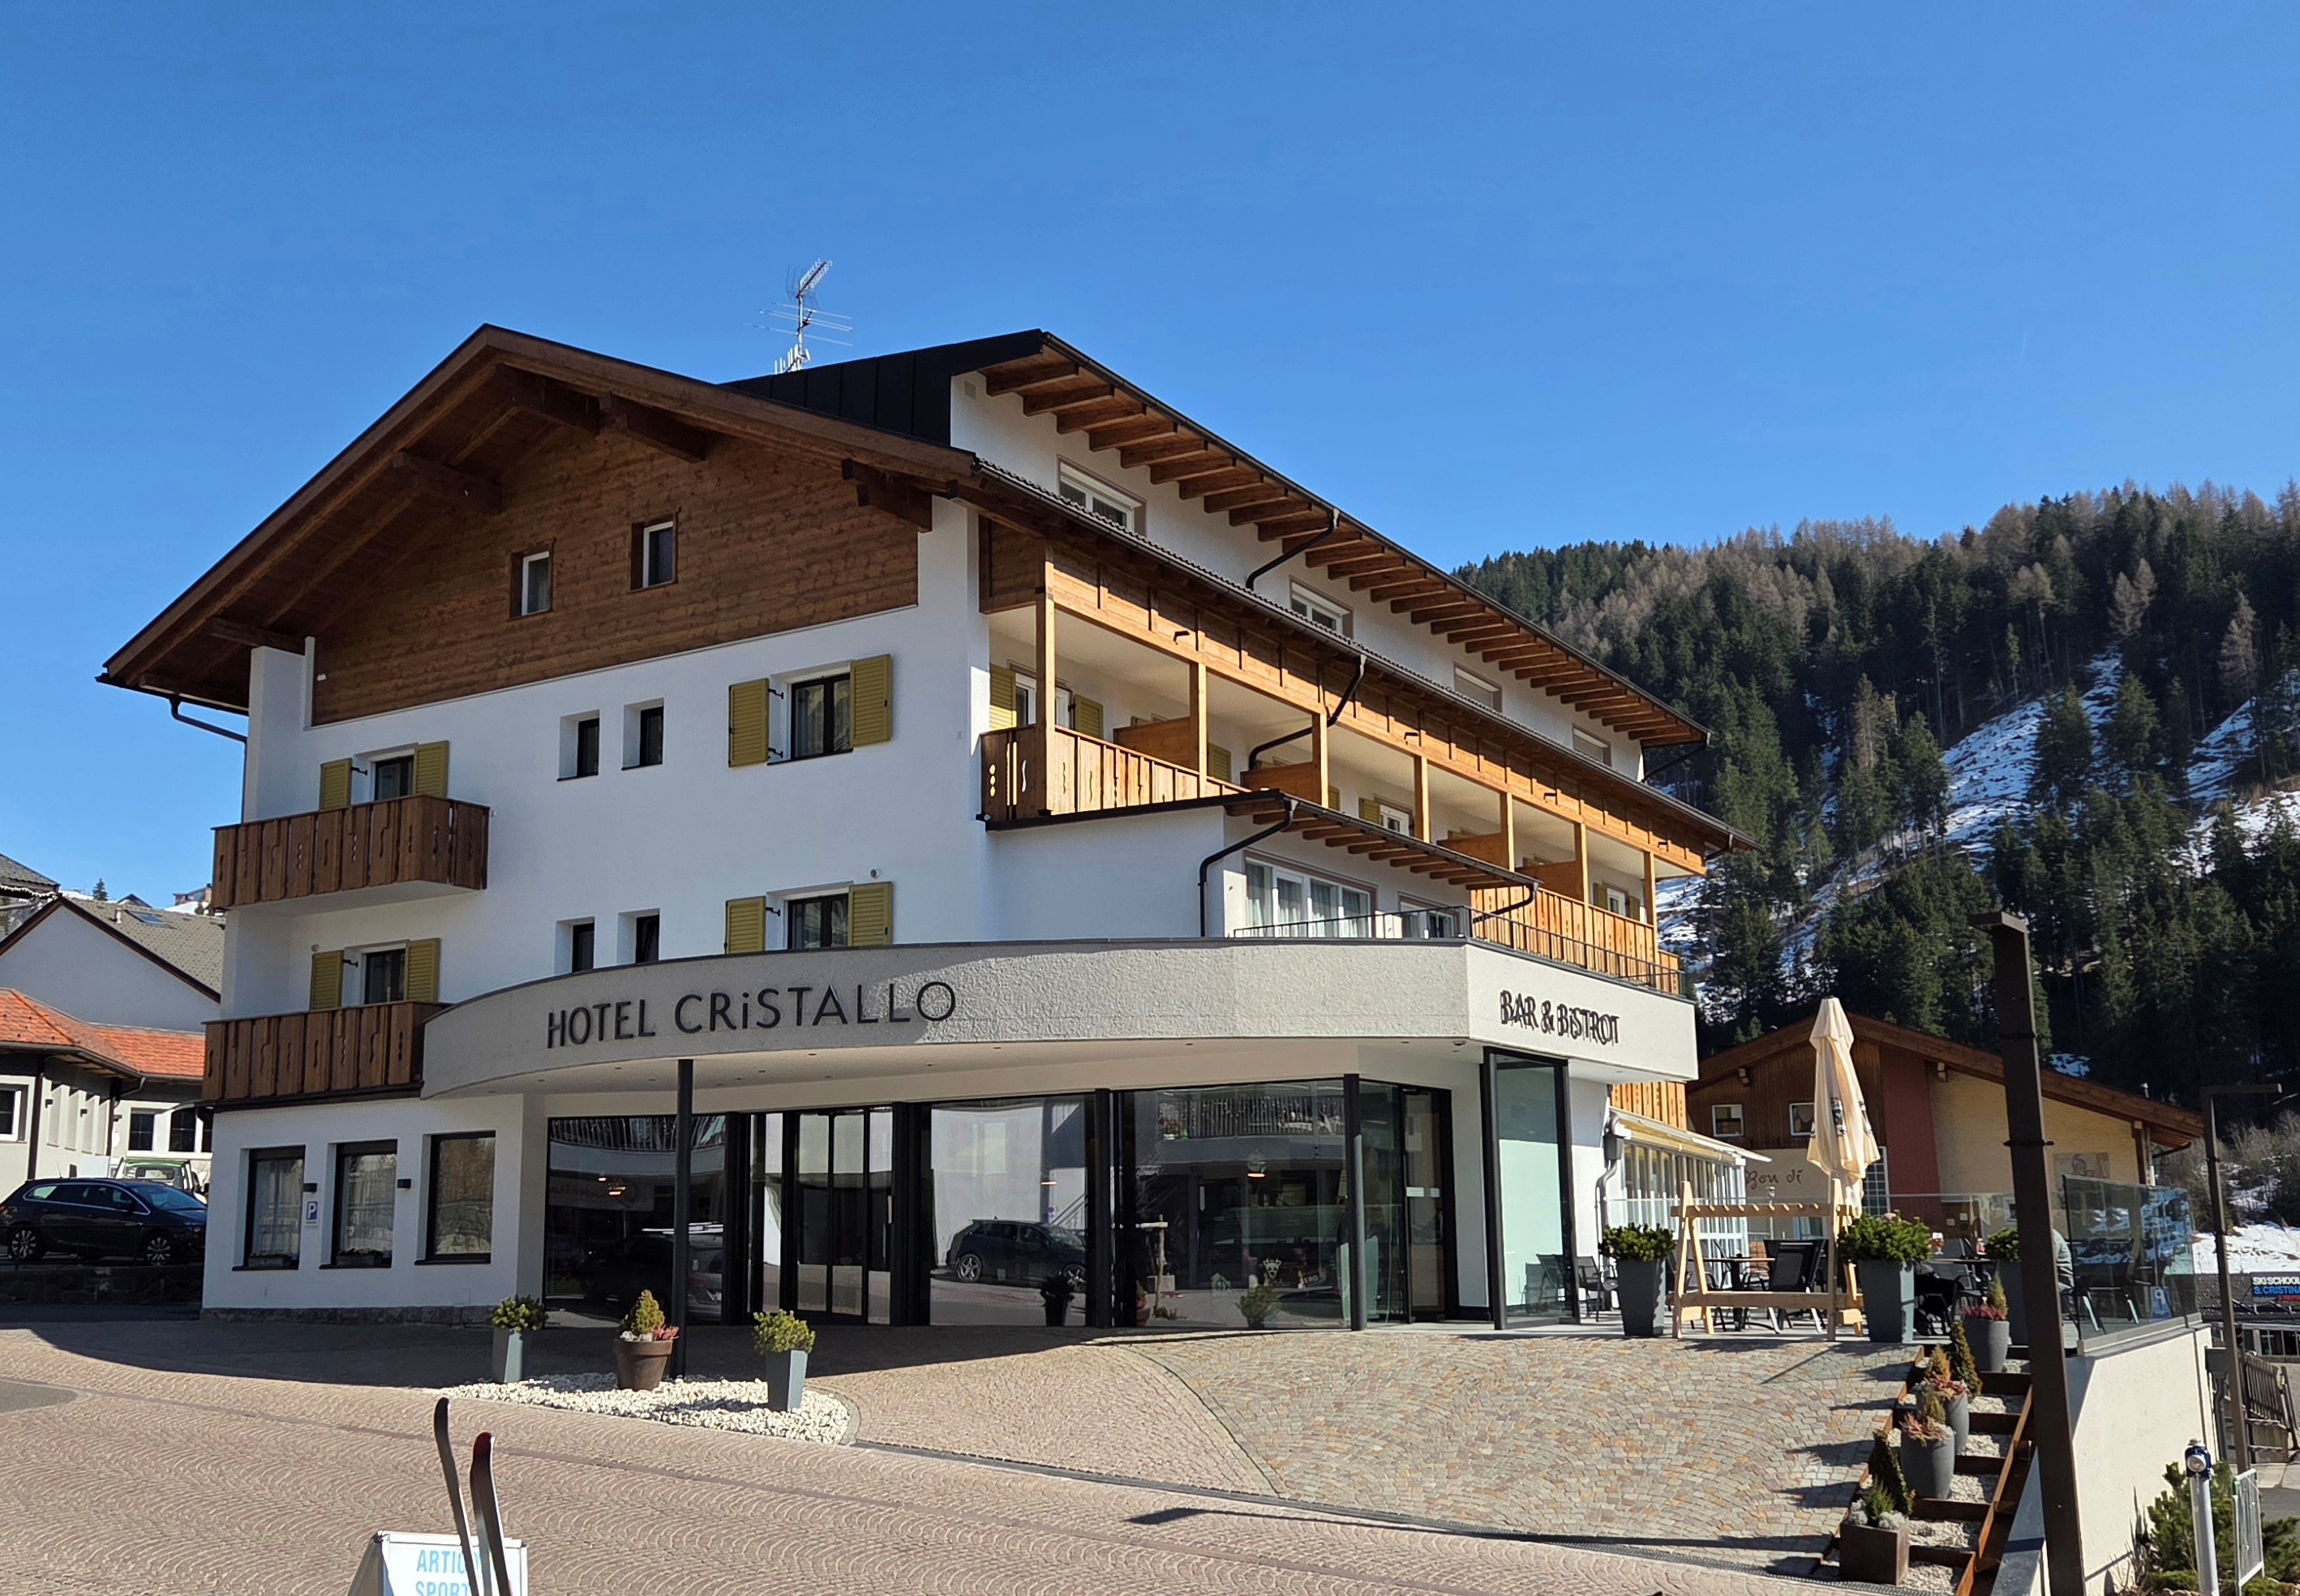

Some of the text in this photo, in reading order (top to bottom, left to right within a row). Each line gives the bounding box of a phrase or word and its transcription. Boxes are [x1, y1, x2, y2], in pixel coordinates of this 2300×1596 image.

[547, 999, 655, 1049] HOTEL
[1500, 990, 1538, 1031] BAR
[1542, 1000, 1555, 1034] &
[307, 1203, 316, 1219] P
[2252, 1276, 2300, 1285] SKI SCHOOL
